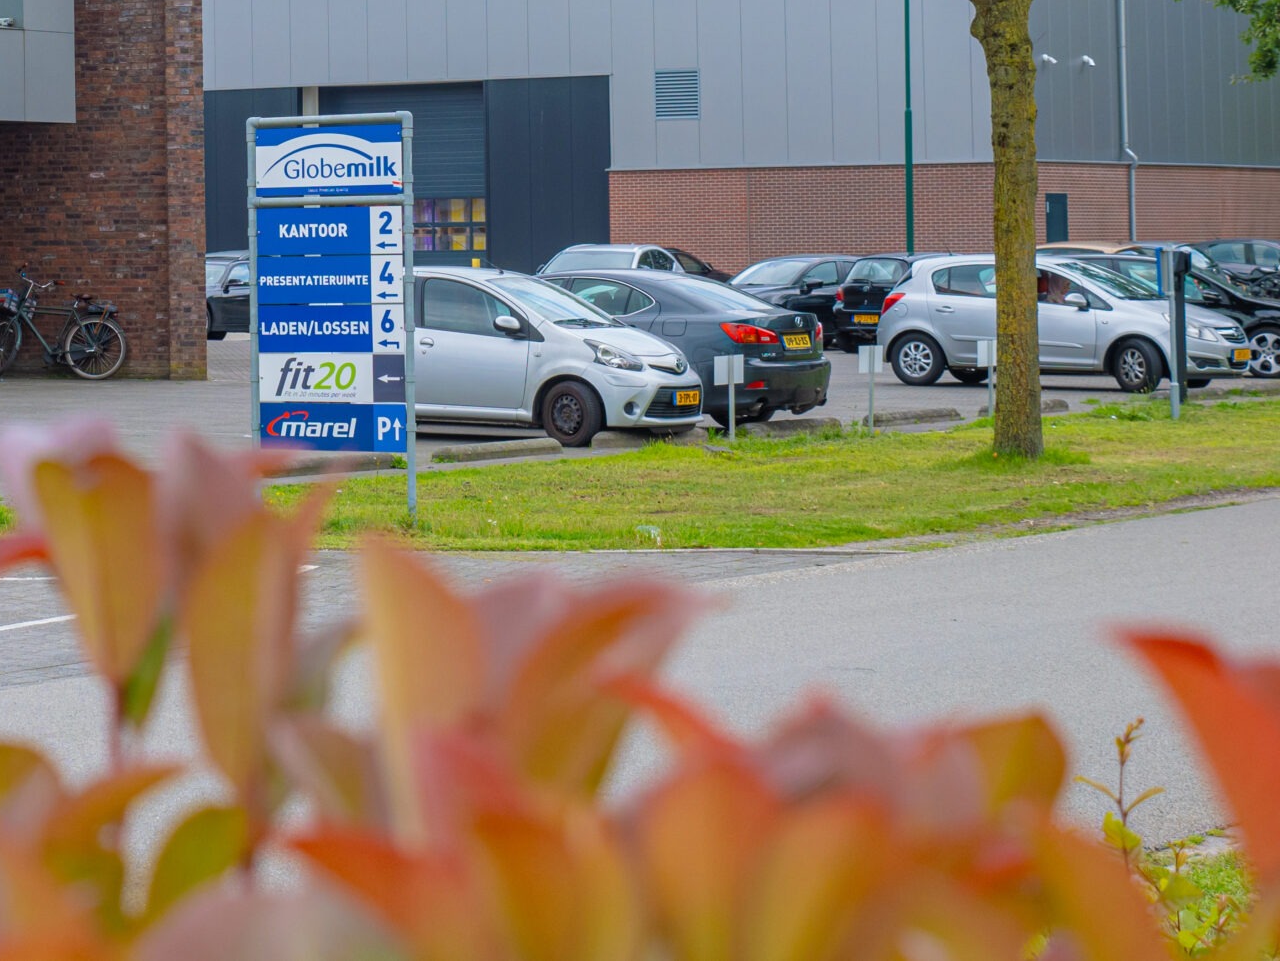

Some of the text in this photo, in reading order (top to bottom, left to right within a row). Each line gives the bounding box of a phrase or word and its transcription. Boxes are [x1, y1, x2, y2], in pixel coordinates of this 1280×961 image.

[284, 156, 397, 179] Globemilk
[279, 211, 392, 238] KANTOOR 2
[260, 261, 394, 287] PRESENTATIERUIMTE 4
[261, 309, 394, 336] LADEN/LOSSEN 6
[275, 357, 357, 396] fit20
[280, 417, 357, 438] marel
[378, 417, 392, 441] P
